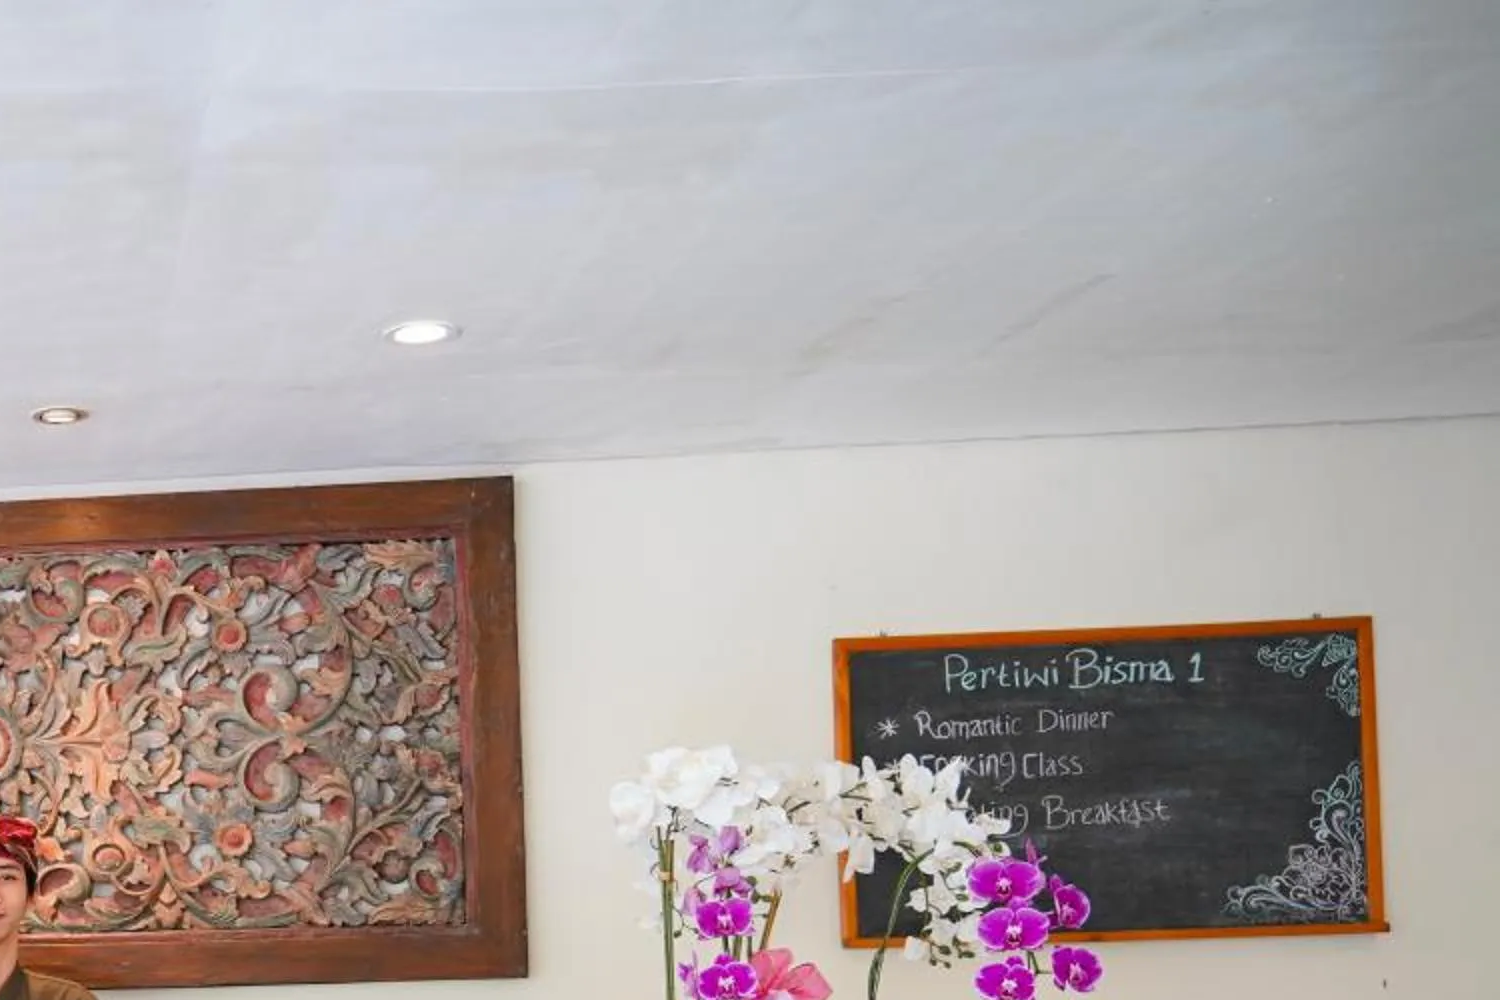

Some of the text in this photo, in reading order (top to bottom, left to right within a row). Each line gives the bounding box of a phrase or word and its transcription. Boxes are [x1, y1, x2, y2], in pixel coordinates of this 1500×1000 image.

[943, 647, 1205, 694] Pertiwi Bisma 1
[913, 708, 1116, 741] Romantic Dinner
[920, 752, 1084, 791] oking Class
[1041, 795, 1171, 829] Breakfast
